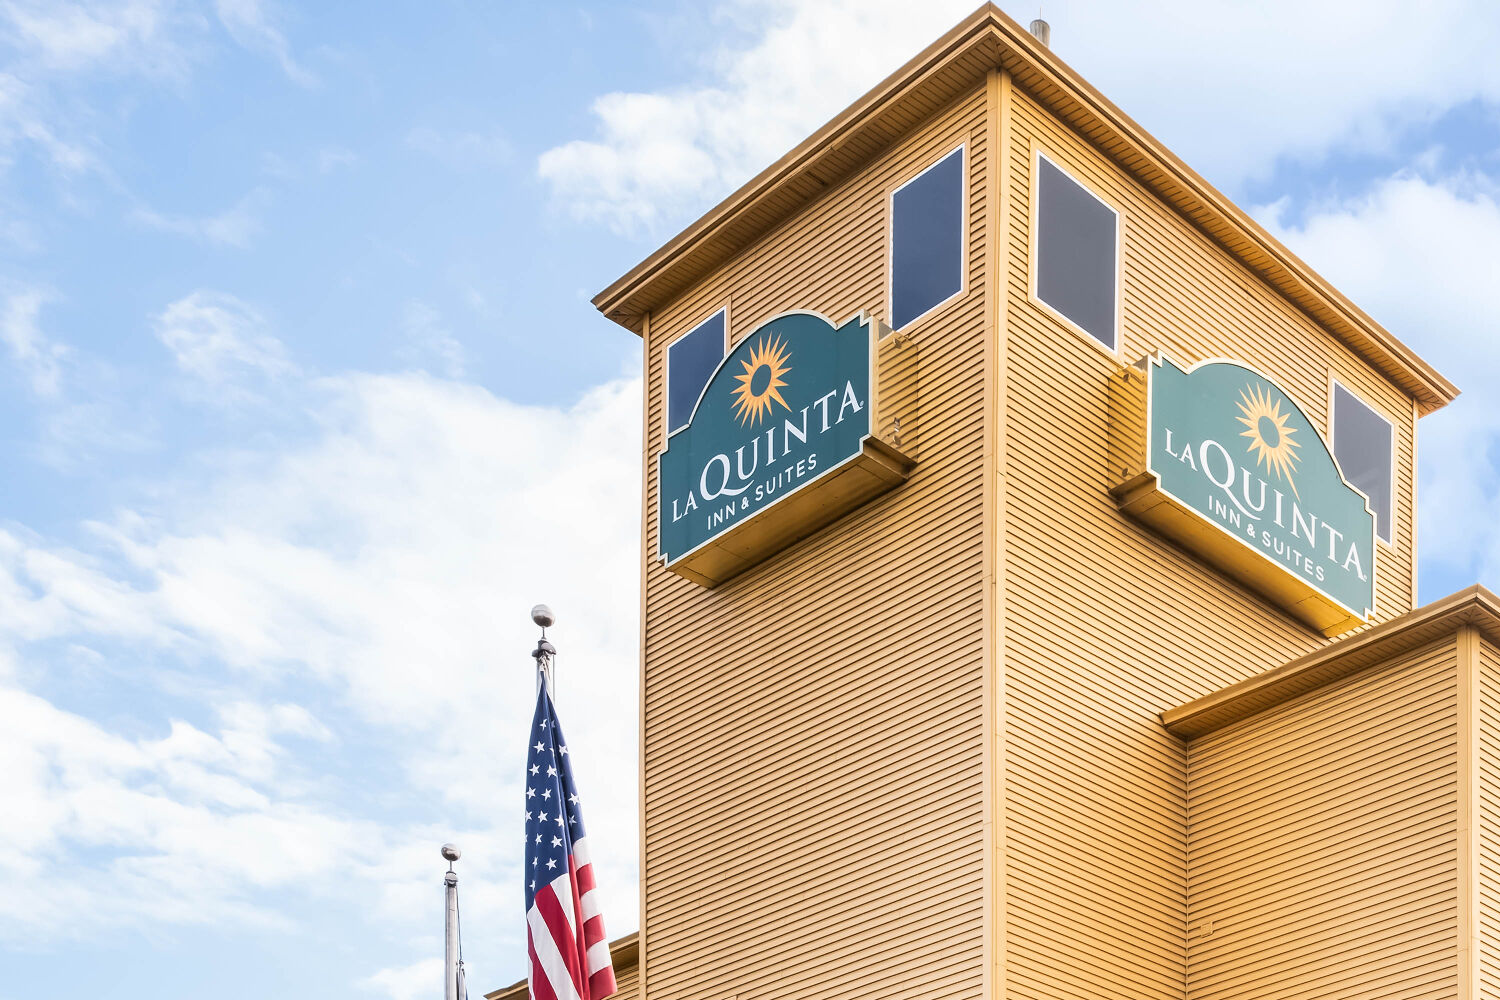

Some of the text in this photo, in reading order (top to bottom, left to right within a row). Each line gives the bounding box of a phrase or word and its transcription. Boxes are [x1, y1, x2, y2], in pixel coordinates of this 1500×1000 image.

[672, 380, 863, 523] LA QUINTA
[707, 453, 817, 530] INN & SUITES
[1164, 427, 1367, 583] LA QUINTA
[1208, 495, 1325, 582] INN & SUITES
